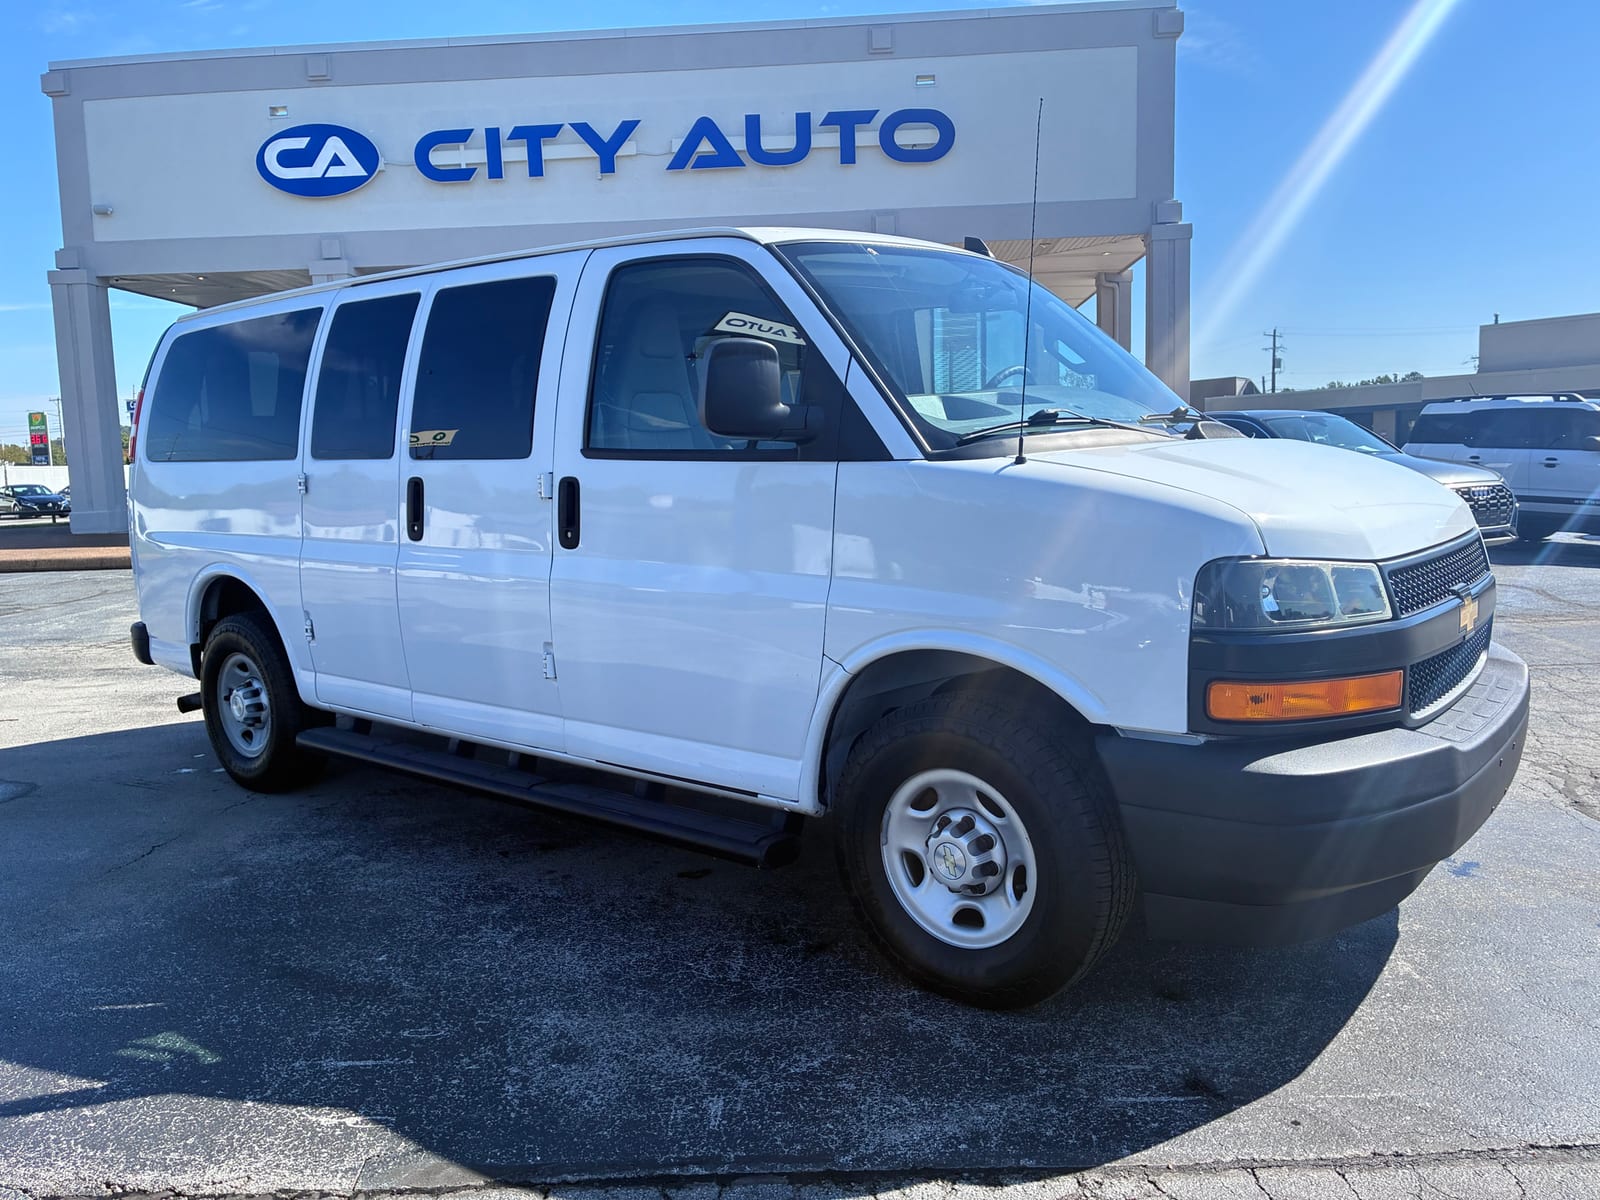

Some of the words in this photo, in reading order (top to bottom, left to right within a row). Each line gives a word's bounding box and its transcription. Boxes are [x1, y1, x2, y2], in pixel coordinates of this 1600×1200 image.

[264, 135, 368, 179] CA
[414, 119, 640, 182] CITY
[667, 108, 955, 170] AUTO
